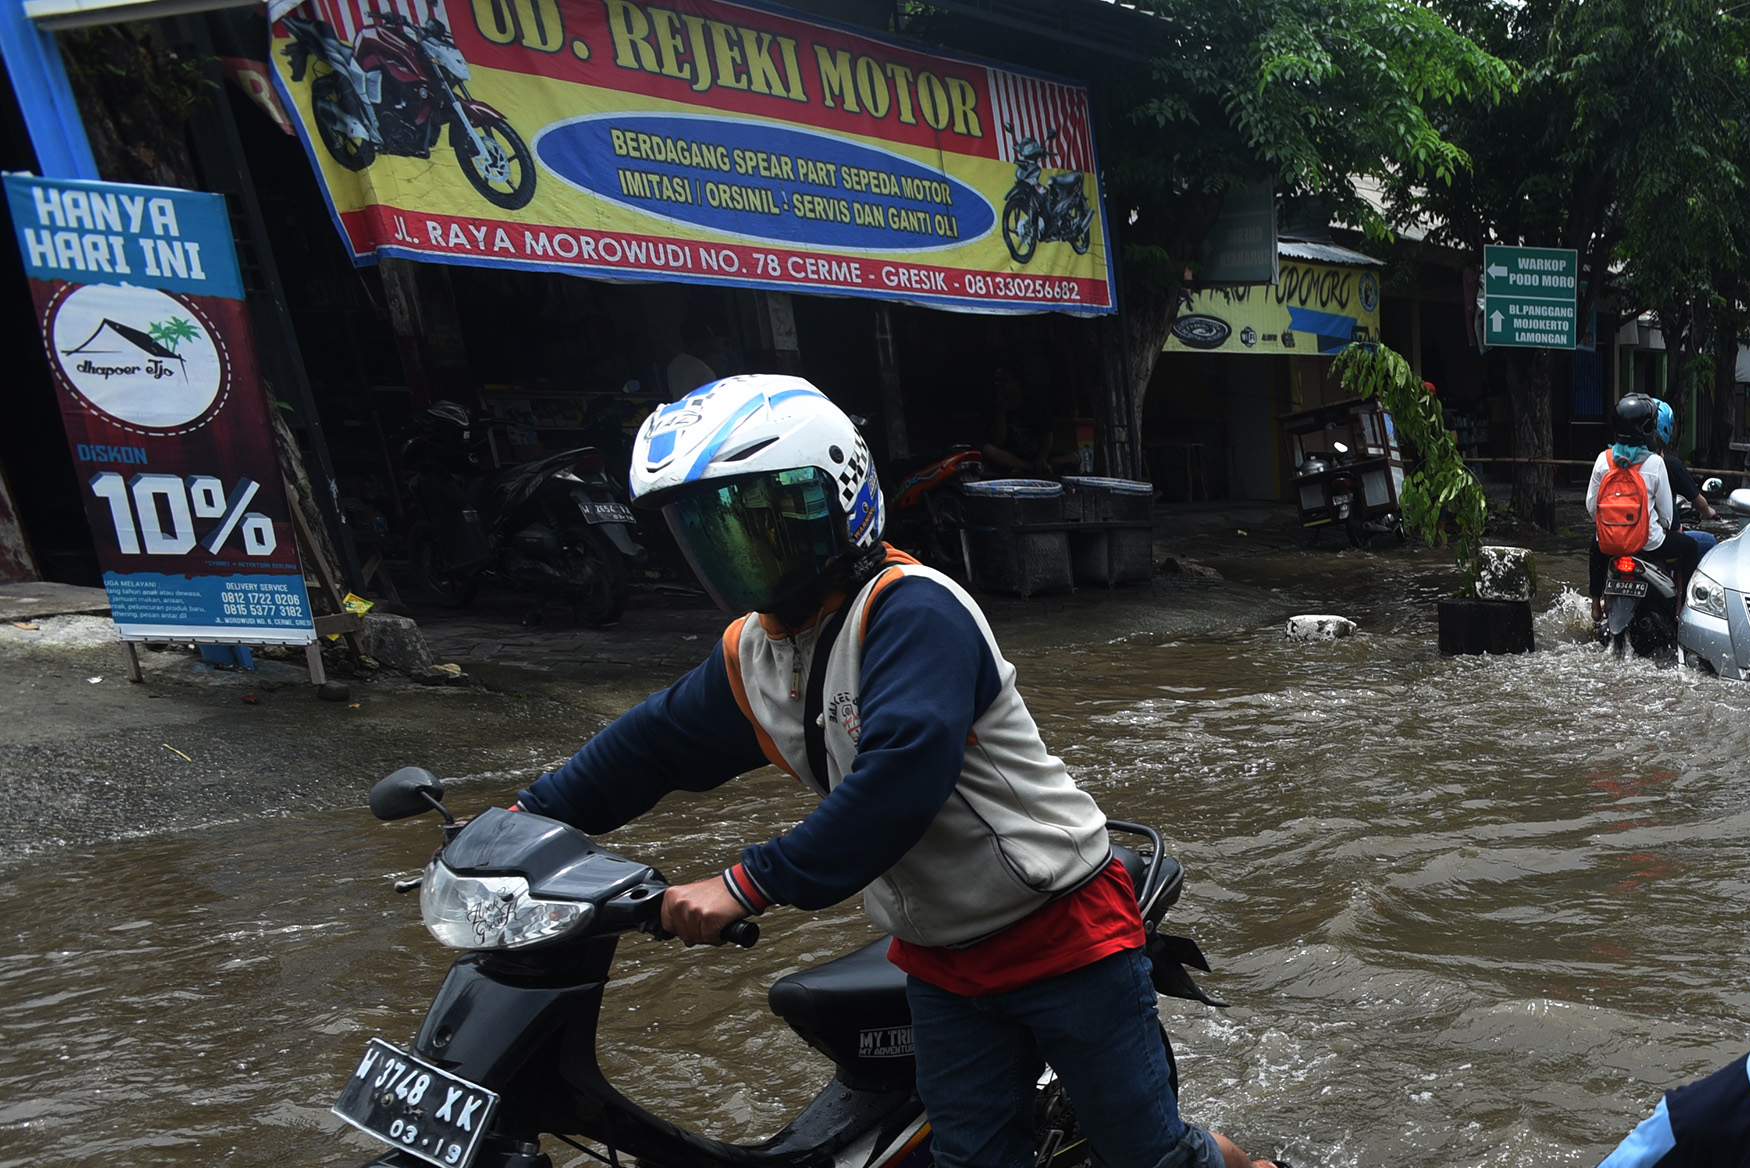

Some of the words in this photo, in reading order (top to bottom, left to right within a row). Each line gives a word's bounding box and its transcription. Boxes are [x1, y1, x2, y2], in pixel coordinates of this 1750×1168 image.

[470, 0, 592, 62] UD.
[606, 0, 809, 103] REJEKI
[813, 44, 984, 138] MOTOR
[610, 127, 731, 173] BERDAGANG
[733, 148, 795, 182] SPEAR
[796, 156, 836, 188] PART
[841, 164, 900, 198] SEPEDA
[901, 175, 952, 206] MOTOR
[32, 186, 180, 237] HANYA
[617, 168, 693, 205] IMITASI
[705, 180, 781, 215] ORSINIL
[792, 193, 850, 225] SERVIS
[853, 201, 885, 229] DAN
[887, 206, 932, 236] GANTI
[934, 213, 959, 239] OLI
[24, 228, 131, 275] HARI
[139, 237, 206, 280] INI
[393, 214, 419, 245] JL.
[425, 220, 515, 253] RAYA
[524, 231, 692, 269] MOROWUDI
[699, 247, 747, 275] NO.
[753, 253, 781, 278] 78
[787, 256, 862, 284] CERME
[882, 266, 948, 291] GRESIK
[965, 274, 1081, 300] 081330256682
[1517, 257, 1566, 272] WARKOP
[1509, 273, 1539, 286] PODO
[1541, 275, 1575, 288] MORO
[1509, 304, 1574, 318] BL.PANGGANG
[1513, 318, 1569, 331] MOJOKERTO
[1515, 332, 1567, 345] LAMONGAN
[88, 471, 277, 556] 10%
[225, 582, 258, 591] DELIVERY
[259, 583, 288, 592] SERVICE
[221, 592, 245, 603] 0812
[248, 593, 272, 604] 1722
[275, 594, 300, 605] 0206
[224, 604, 247, 615] 0815
[249, 604, 276, 616] 5377
[280, 605, 303, 617] 3182
[860, 1031, 884, 1048] MY
[859, 1047, 873, 1056] MY
[356, 1048, 380, 1079] W
[374, 1058, 430, 1106] 3748
[435, 1087, 482, 1132] XK
